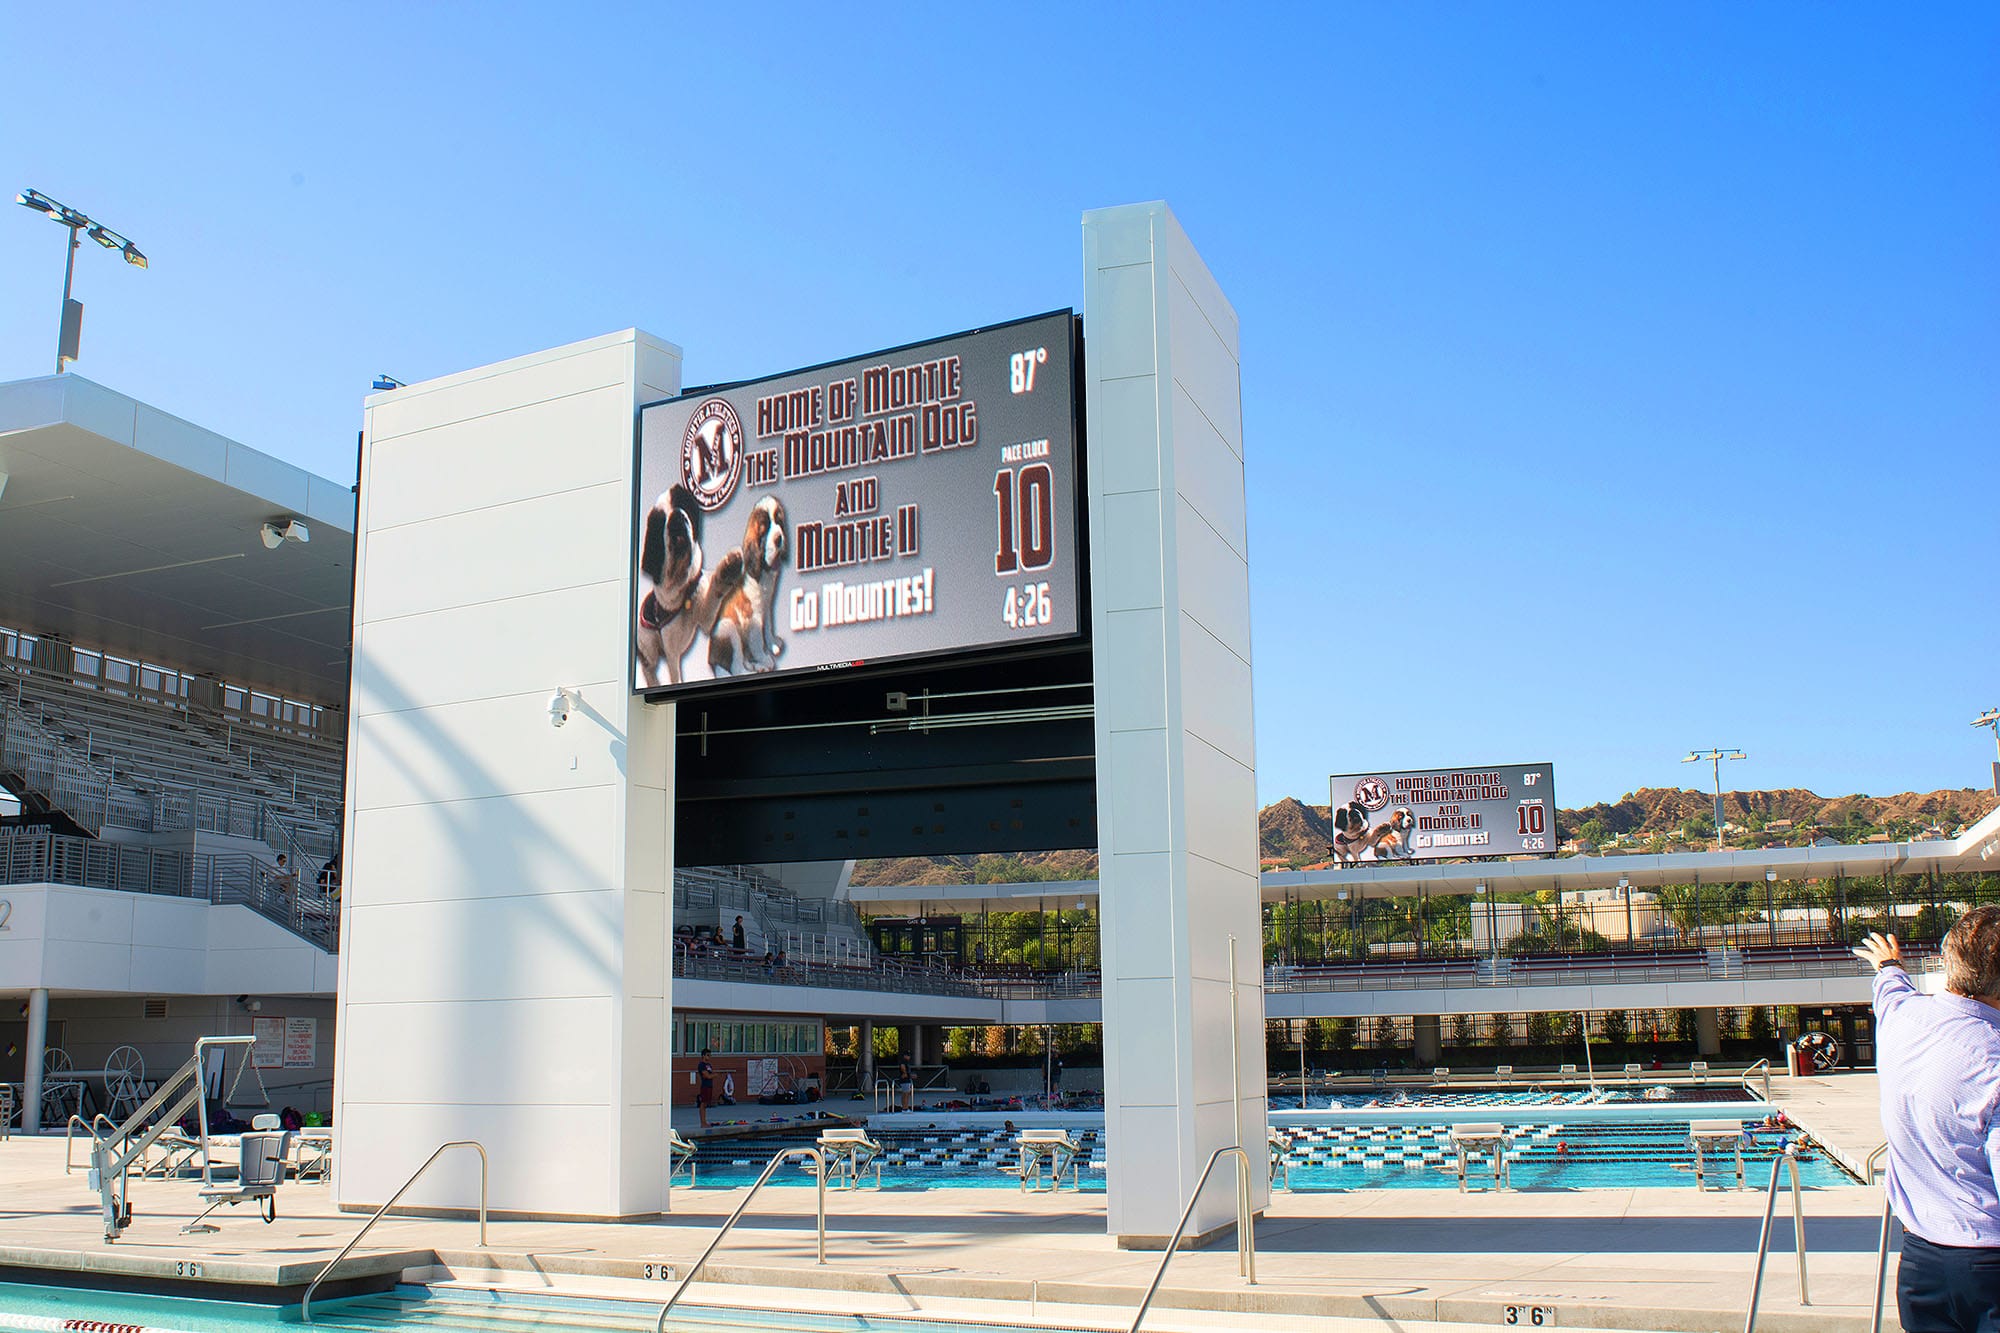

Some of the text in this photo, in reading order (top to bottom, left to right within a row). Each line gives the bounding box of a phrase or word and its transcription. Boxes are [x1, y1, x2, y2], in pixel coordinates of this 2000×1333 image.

[695, 421, 730, 484] M
[1002, 439, 1049, 463] PACE CLOCK
[993, 463, 1054, 576] 10
[1003, 582, 1052, 629] 4:26
[1516, 804, 1546, 836] 10
[1522, 837, 1545, 850] 4:26
[177, 1261, 197, 1277] 3 6
[645, 1264, 653, 1279] 3
[660, 1265, 668, 1280] 6
[1506, 1306, 1518, 1324] 3
[1531, 1307, 1543, 1326] 6
